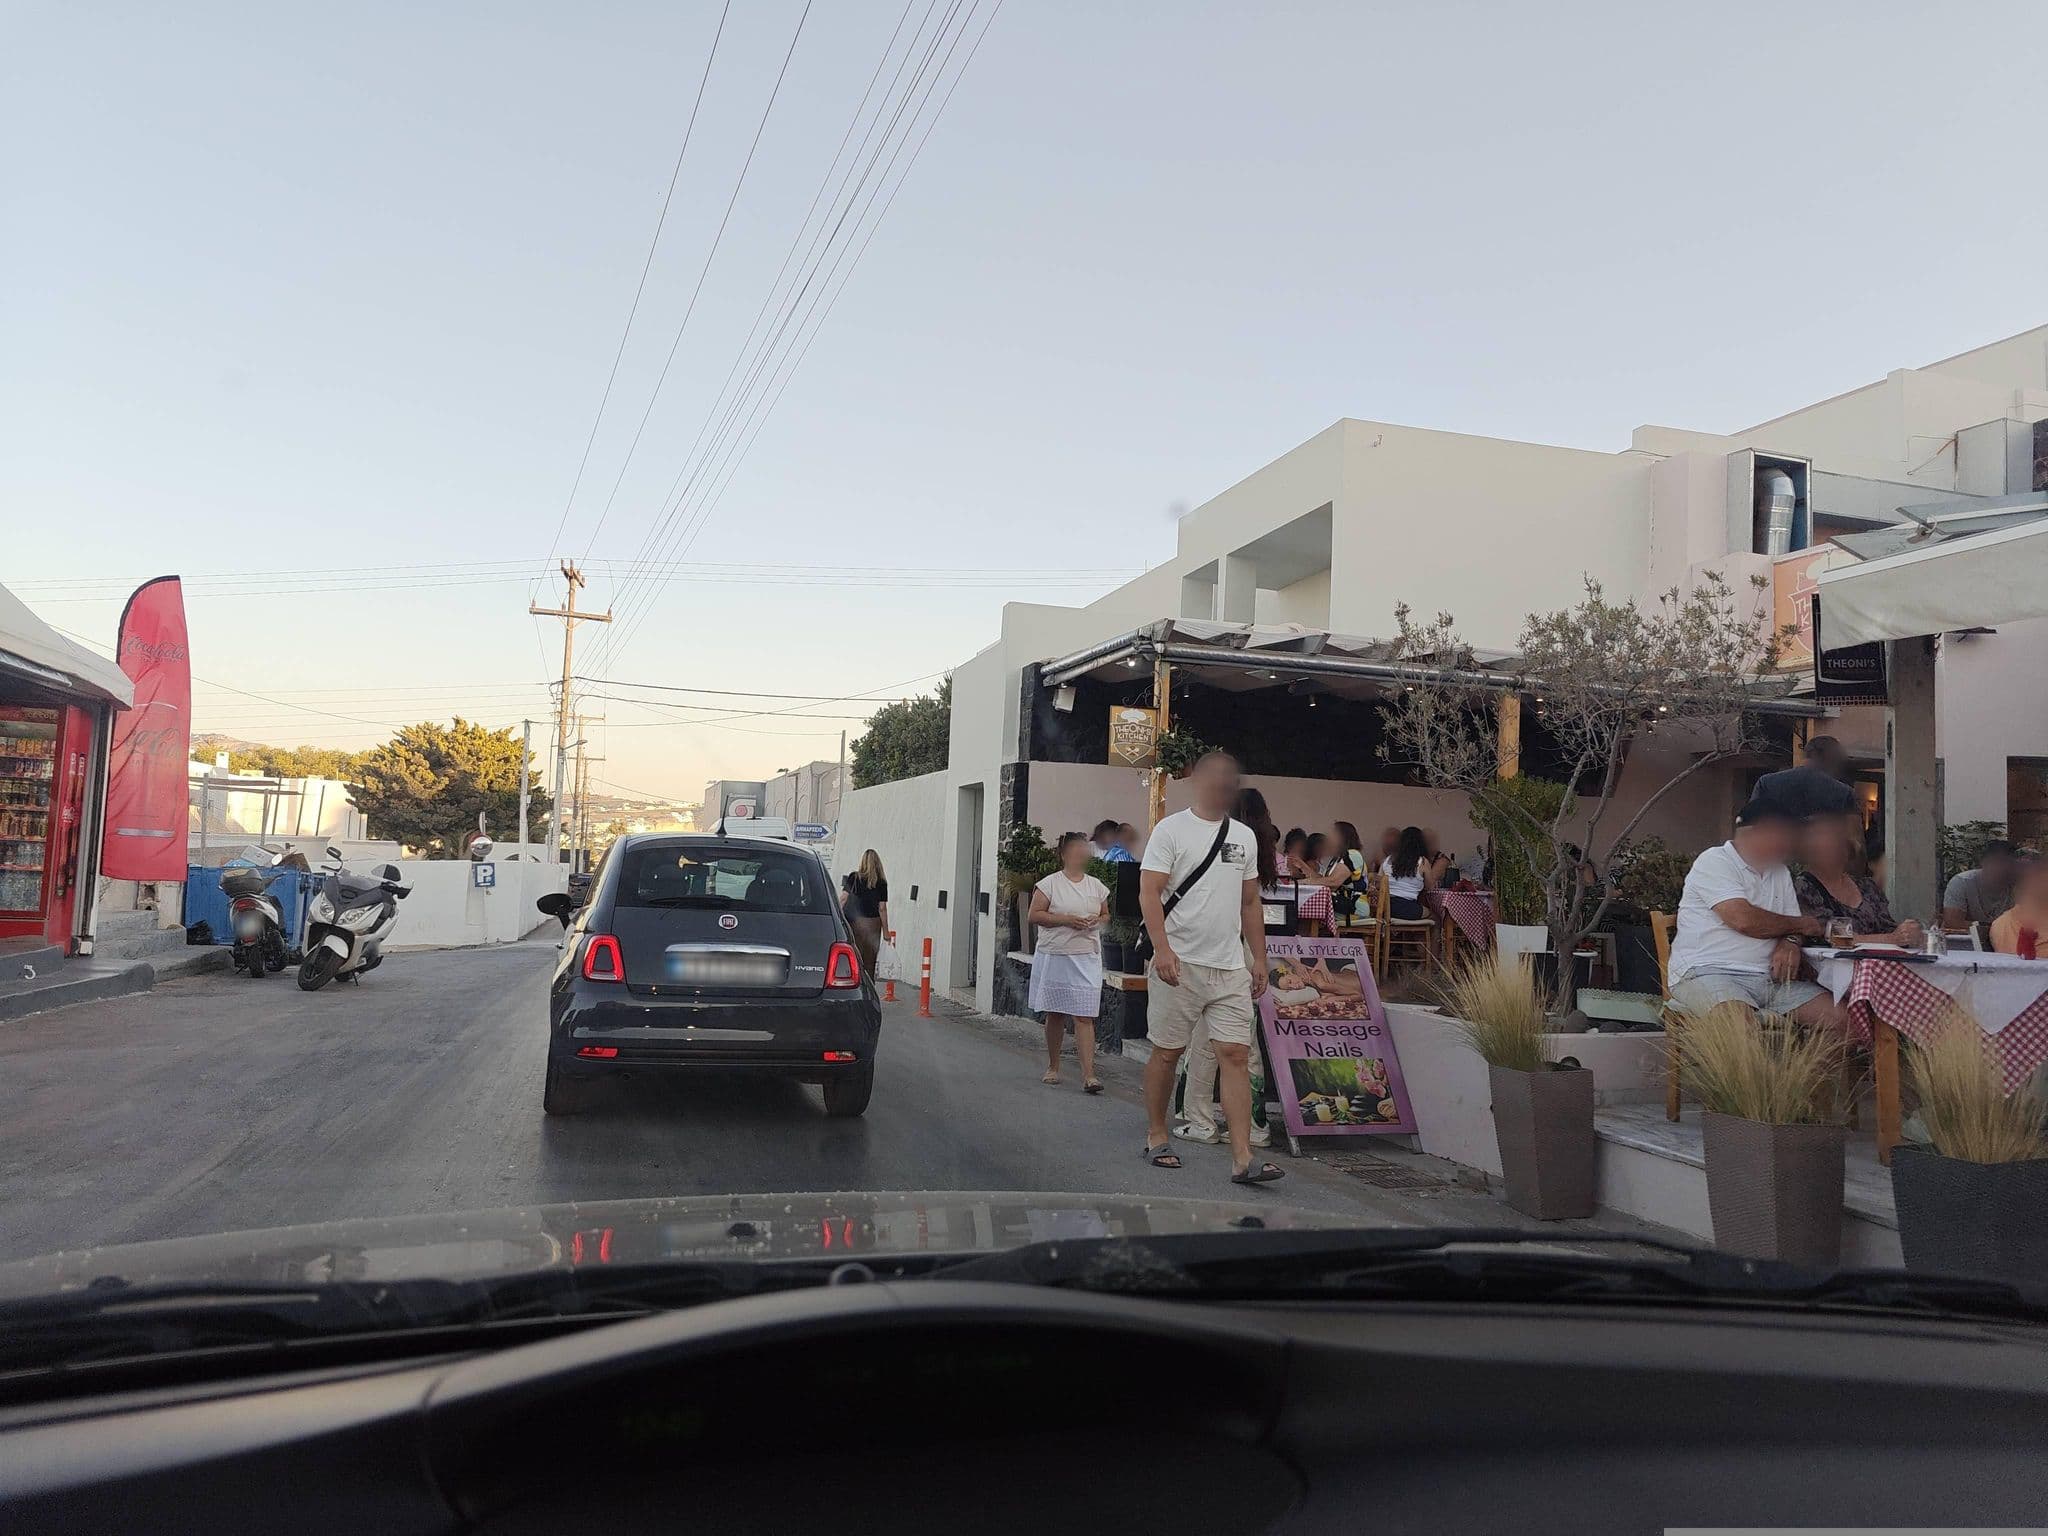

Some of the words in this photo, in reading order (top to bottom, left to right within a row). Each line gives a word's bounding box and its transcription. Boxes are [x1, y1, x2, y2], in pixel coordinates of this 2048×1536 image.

[1826, 658, 1875, 669] THEONI'S
[1117, 733, 1149, 741] KITCHEN
[476, 865, 493, 883] P
[722, 917, 734, 926] FIAT
[1265, 944, 1293, 954] AUTY
[1296, 945, 1304, 955] &
[1309, 945, 1338, 956] STYLE
[1341, 946, 1363, 957] CGR
[1273, 1020, 1382, 1041] Massage
[1304, 1041, 1364, 1058] Nails
